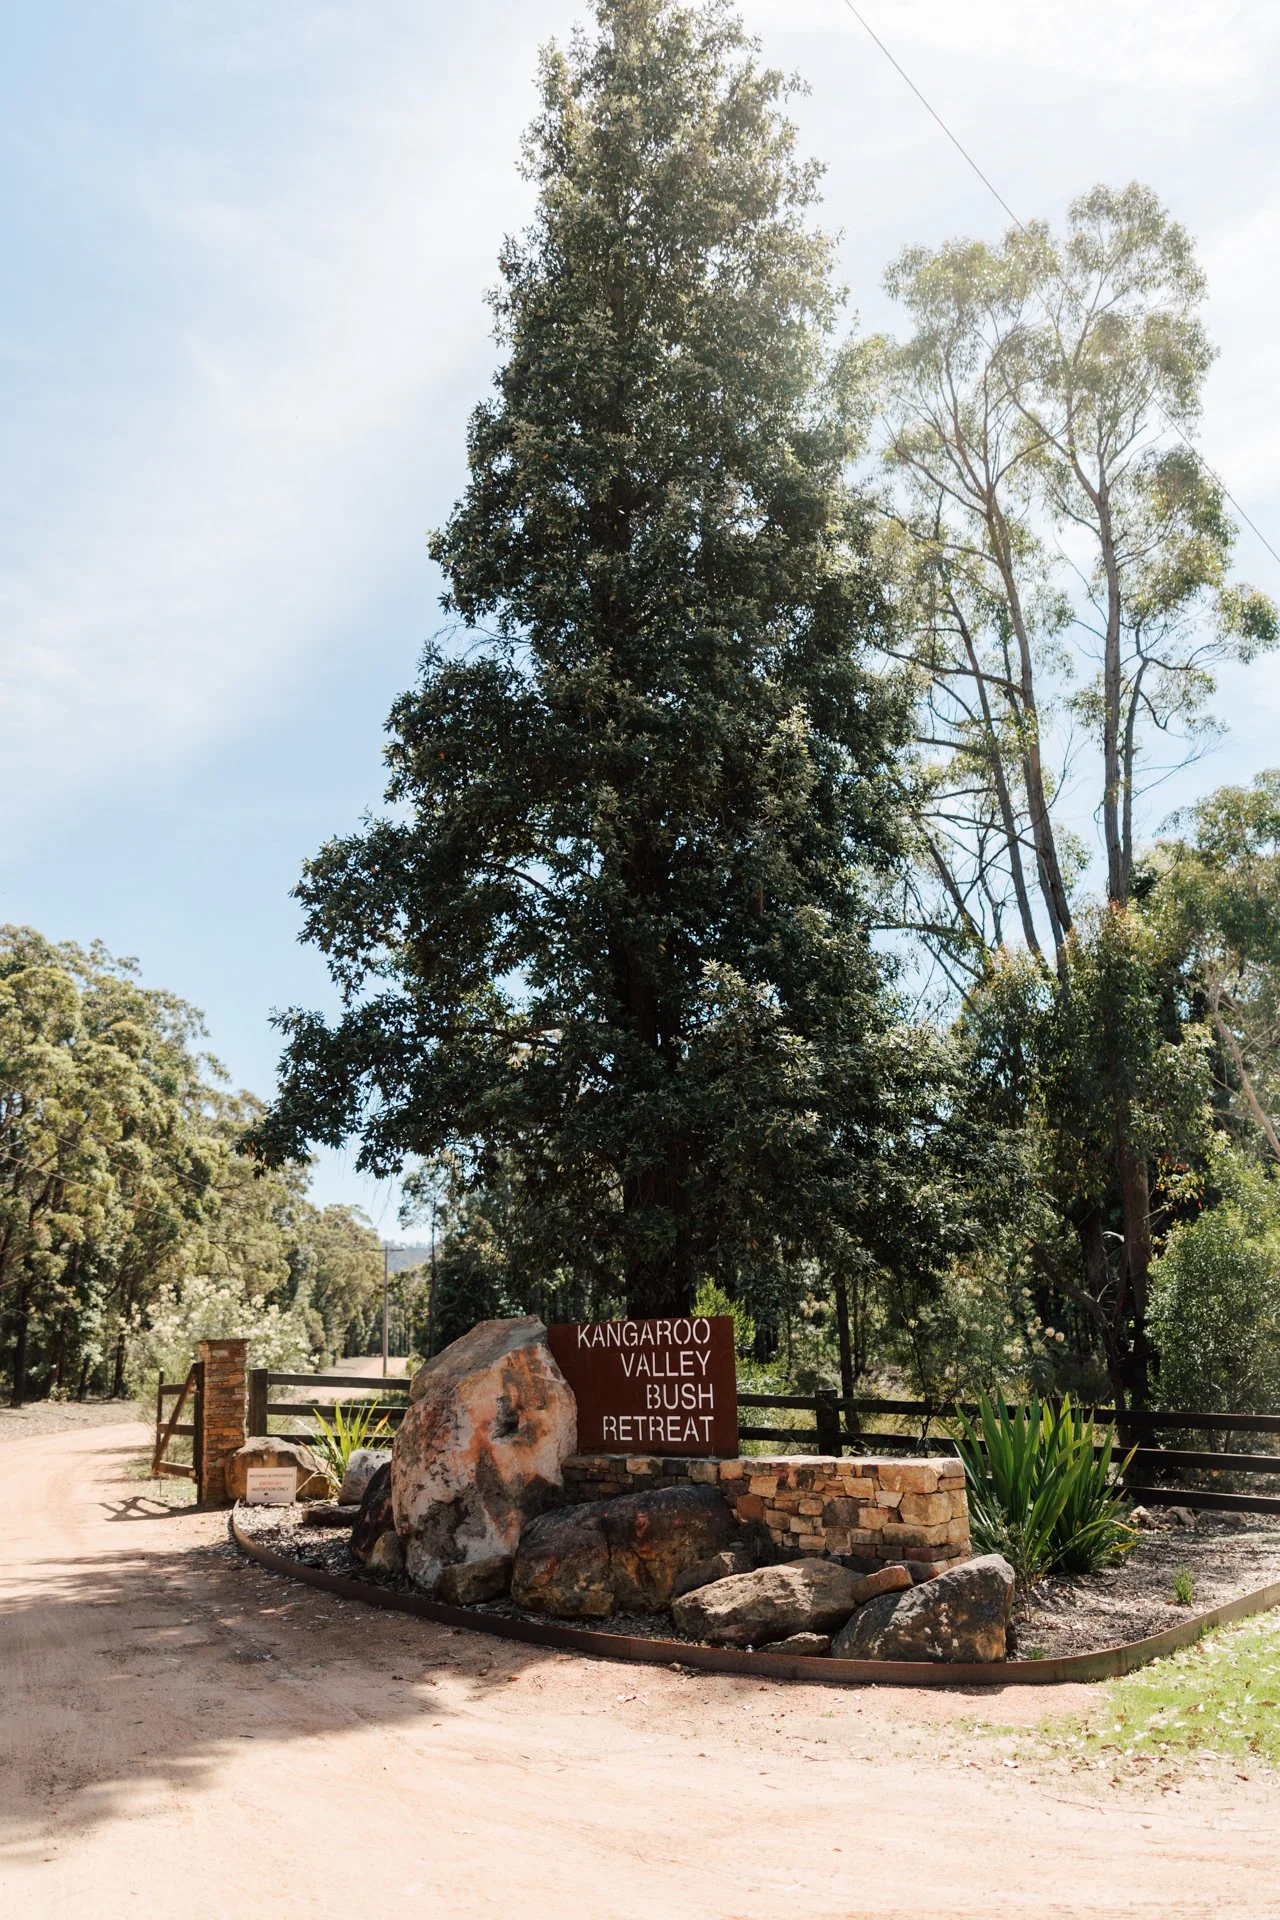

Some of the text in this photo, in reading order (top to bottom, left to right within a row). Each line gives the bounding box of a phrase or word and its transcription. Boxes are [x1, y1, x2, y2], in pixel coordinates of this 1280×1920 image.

[577, 1318, 711, 1348] KANGAROO
[620, 1350, 711, 1377] VALLEY
[646, 1383, 714, 1410] BUSH
[602, 1415, 714, 1442] RETREAT
